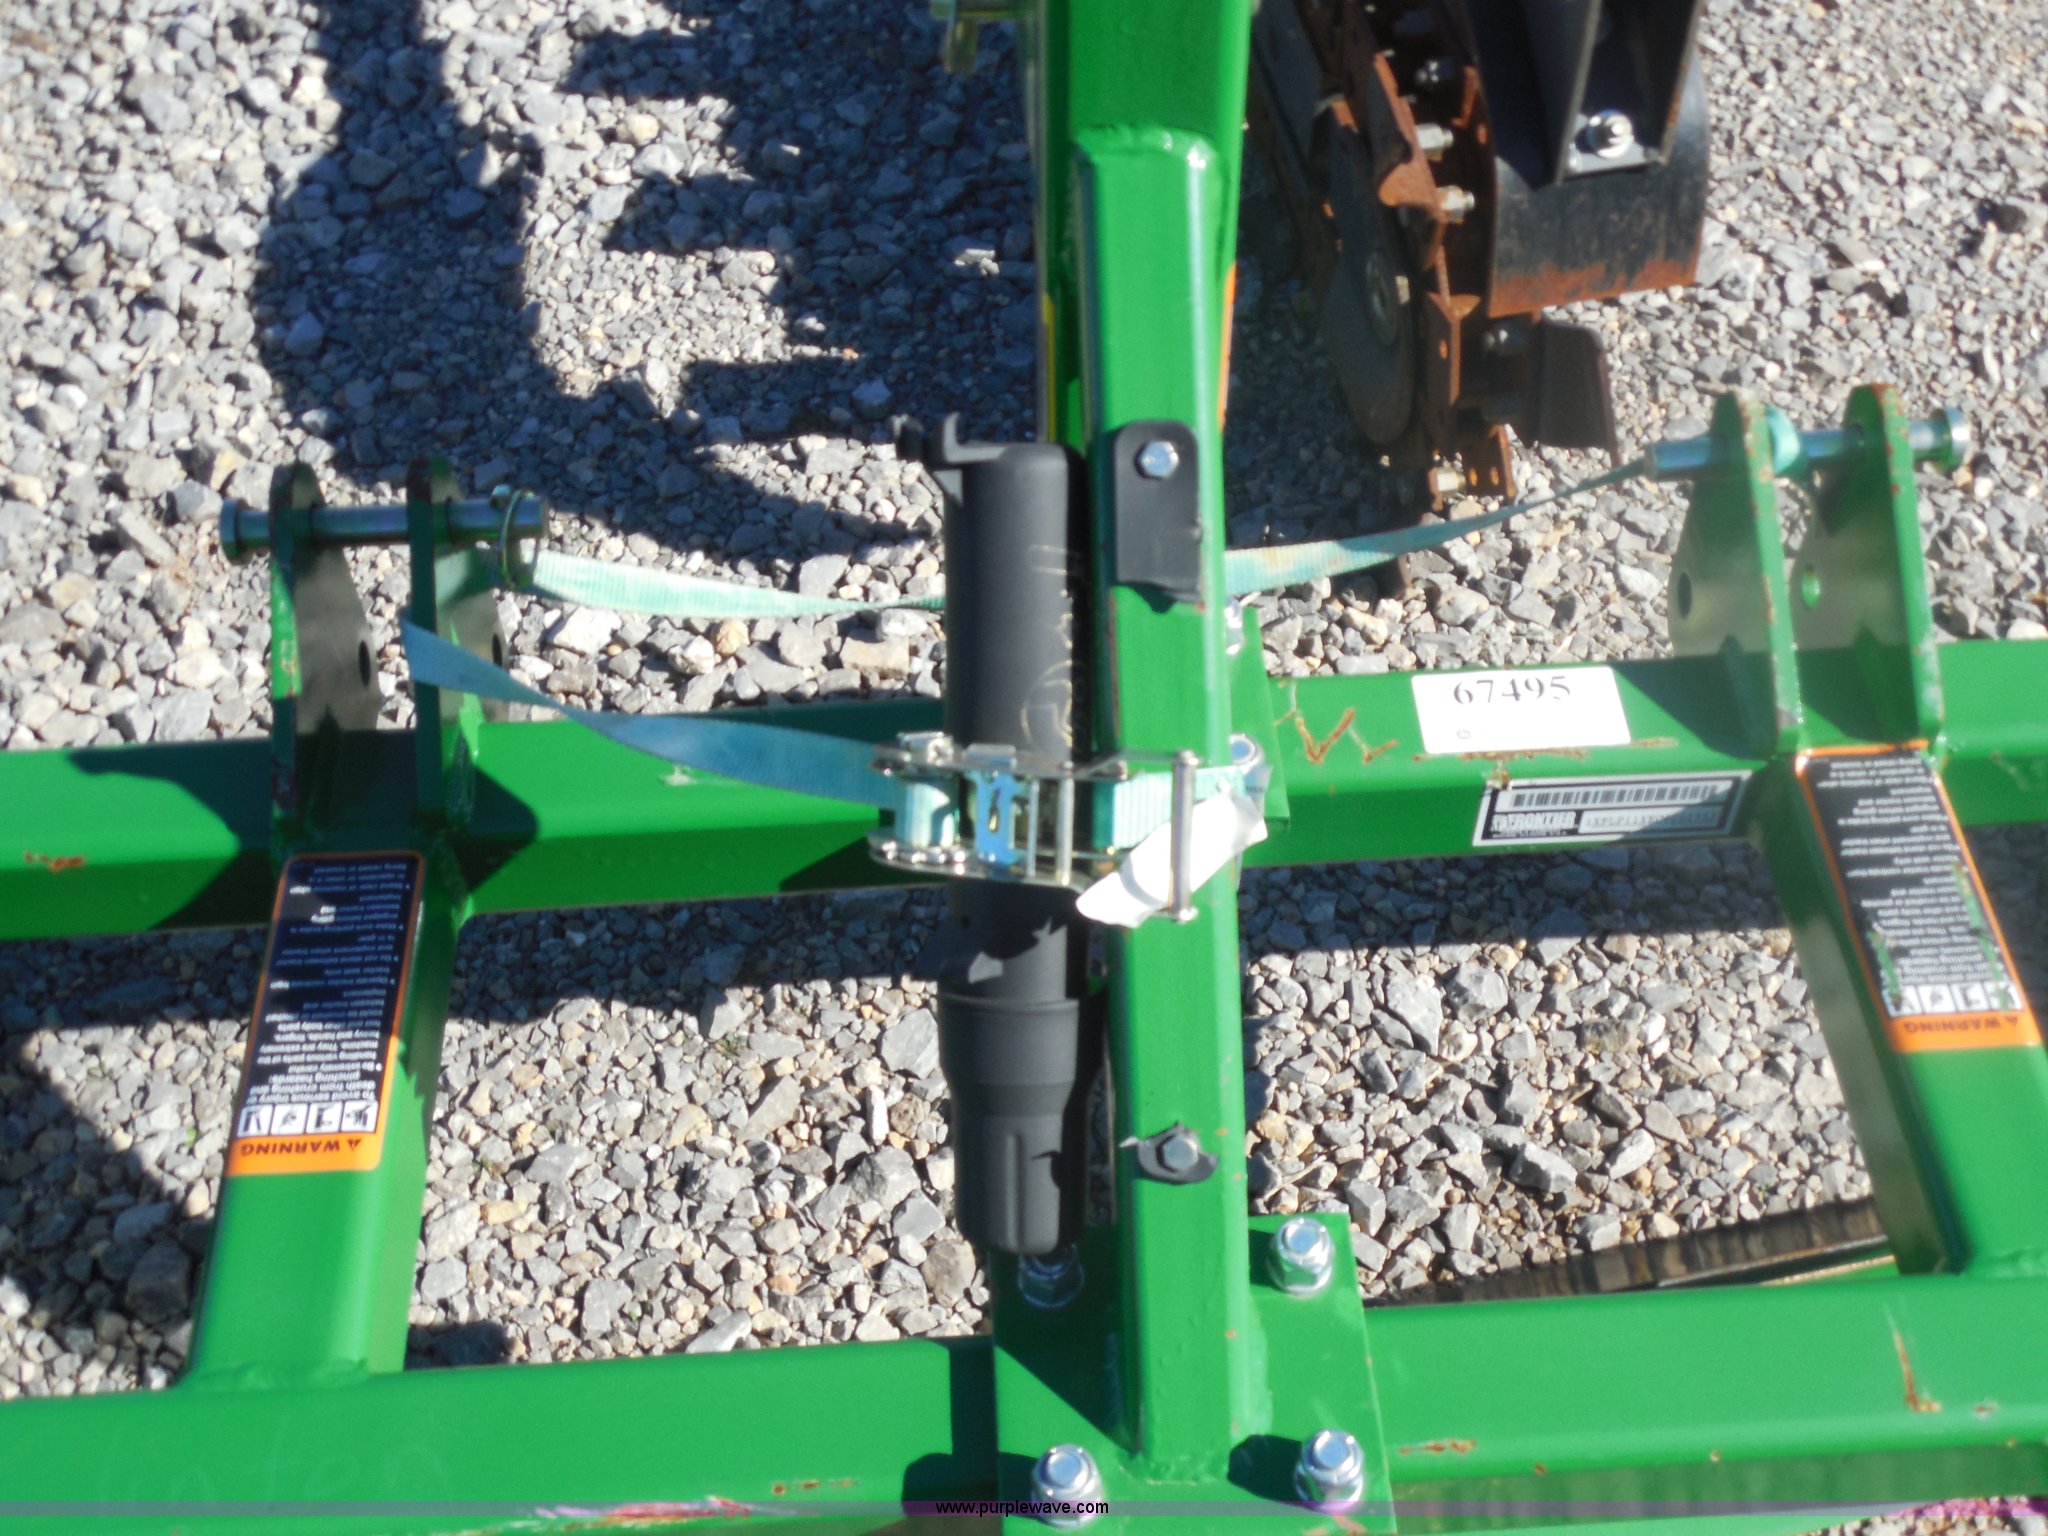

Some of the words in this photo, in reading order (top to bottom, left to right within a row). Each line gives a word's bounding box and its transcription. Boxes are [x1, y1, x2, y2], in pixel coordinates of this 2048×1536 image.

[1453, 675, 1571, 704] 67495
[1904, 1018, 2000, 1033] WARNING
[241, 1141, 340, 1156] WARNING
